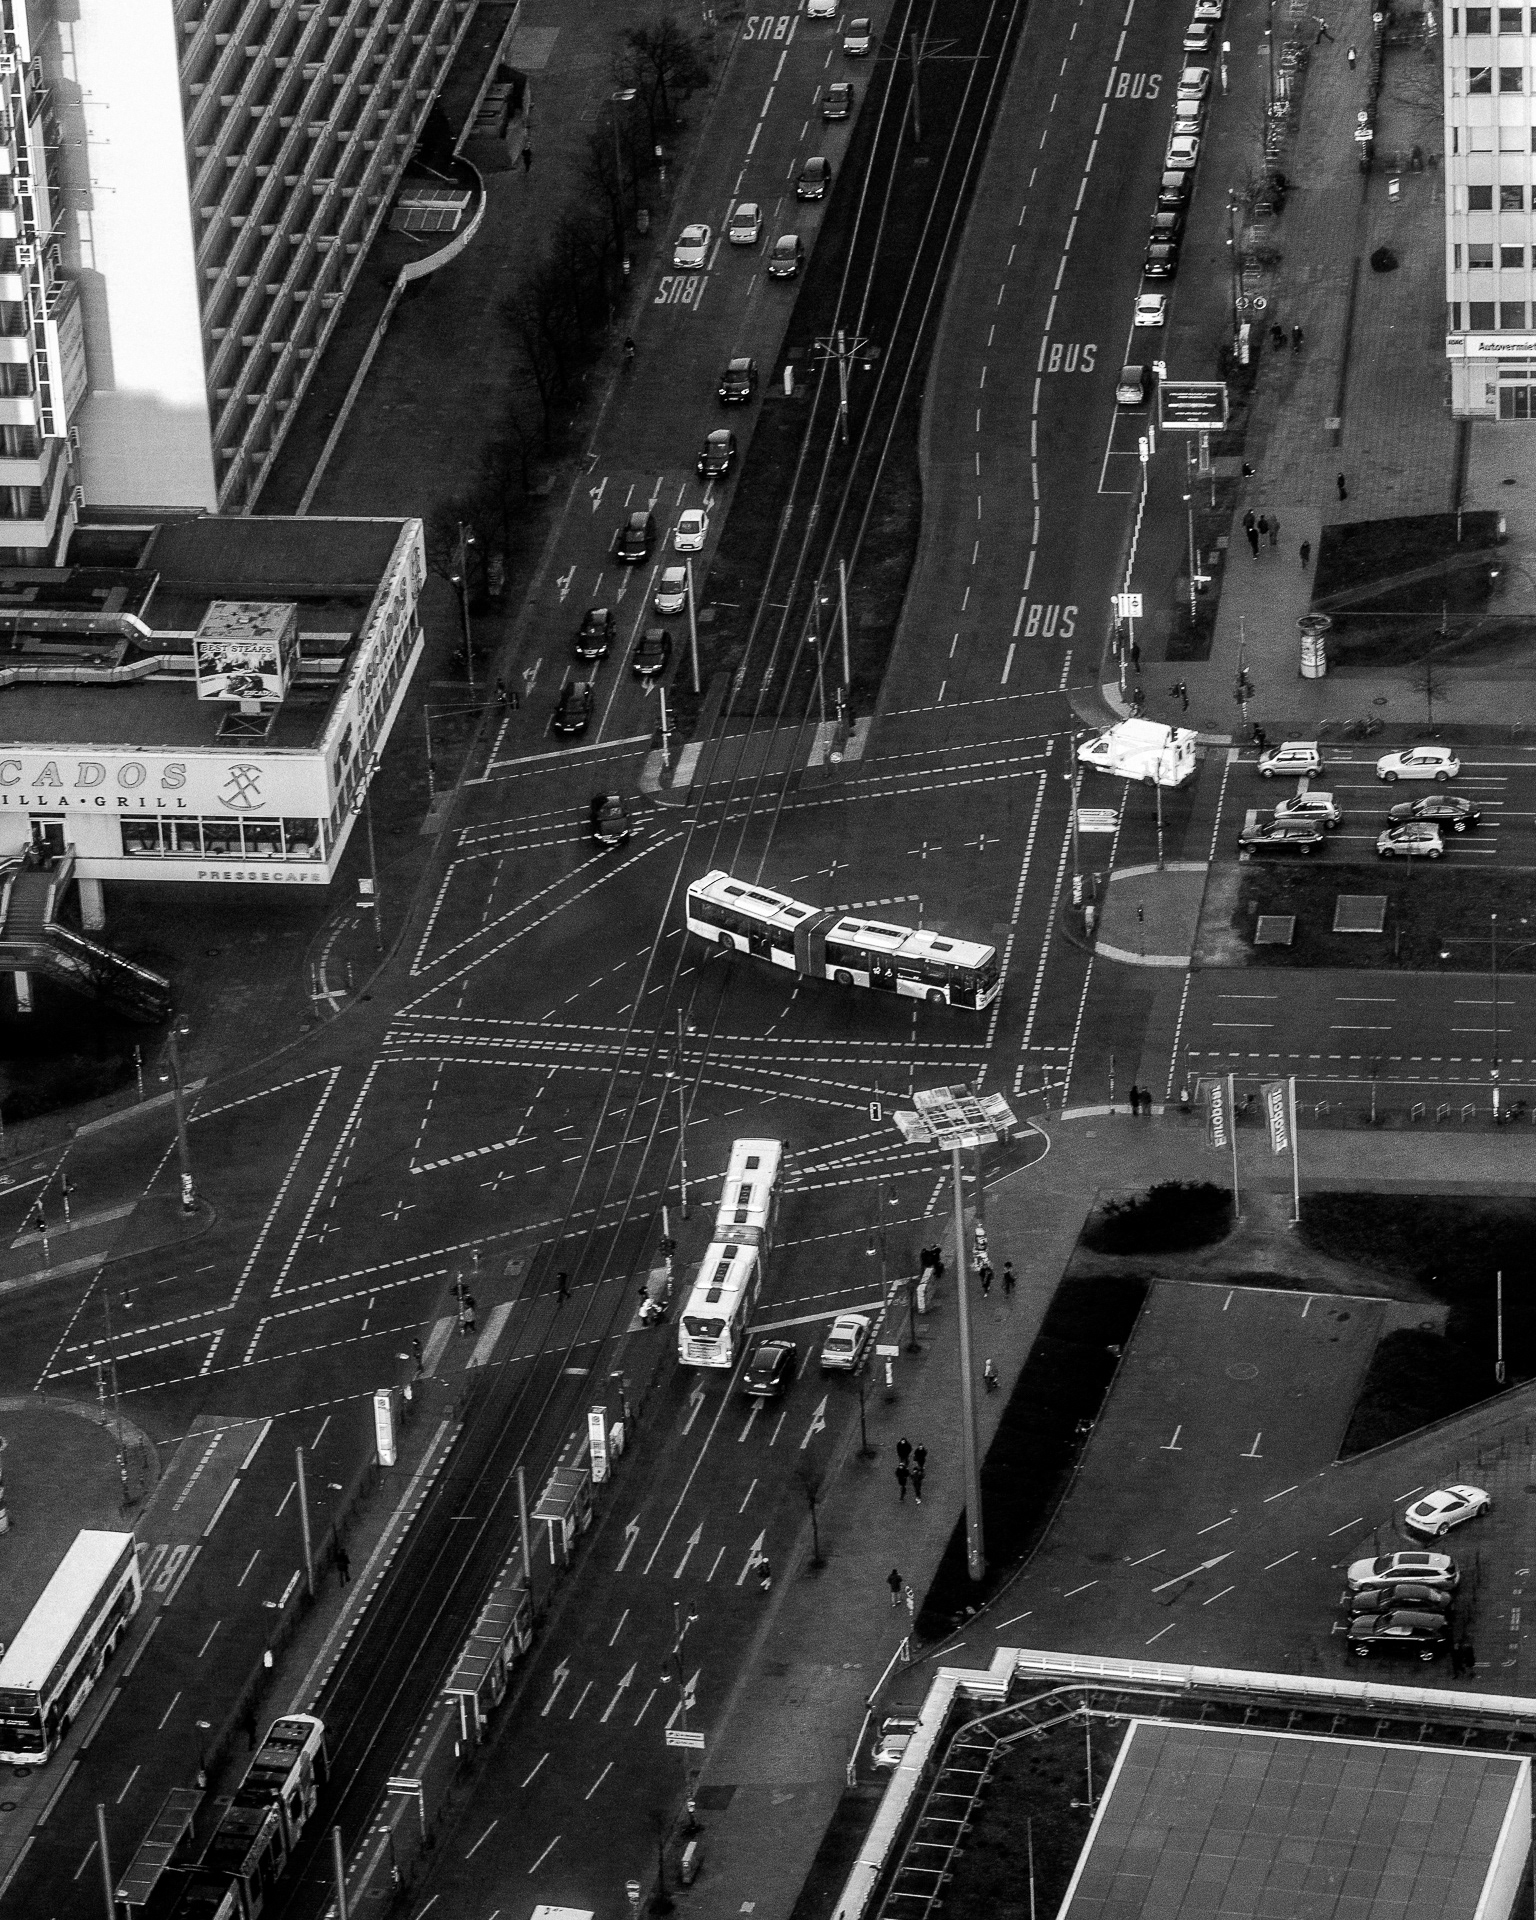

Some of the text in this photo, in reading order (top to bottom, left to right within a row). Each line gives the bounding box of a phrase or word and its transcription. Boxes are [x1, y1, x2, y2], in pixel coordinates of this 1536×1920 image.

[742, 15, 789, 39] BUS
[1115, 72, 1162, 99] BUS
[654, 276, 699, 303] BUS
[1048, 344, 1098, 372] BUS
[1024, 604, 1078, 637] BUS
[201, 644, 227, 652] BEST
[0, 759, 187, 790] CADOS
[135, 1541, 191, 1593] BU
